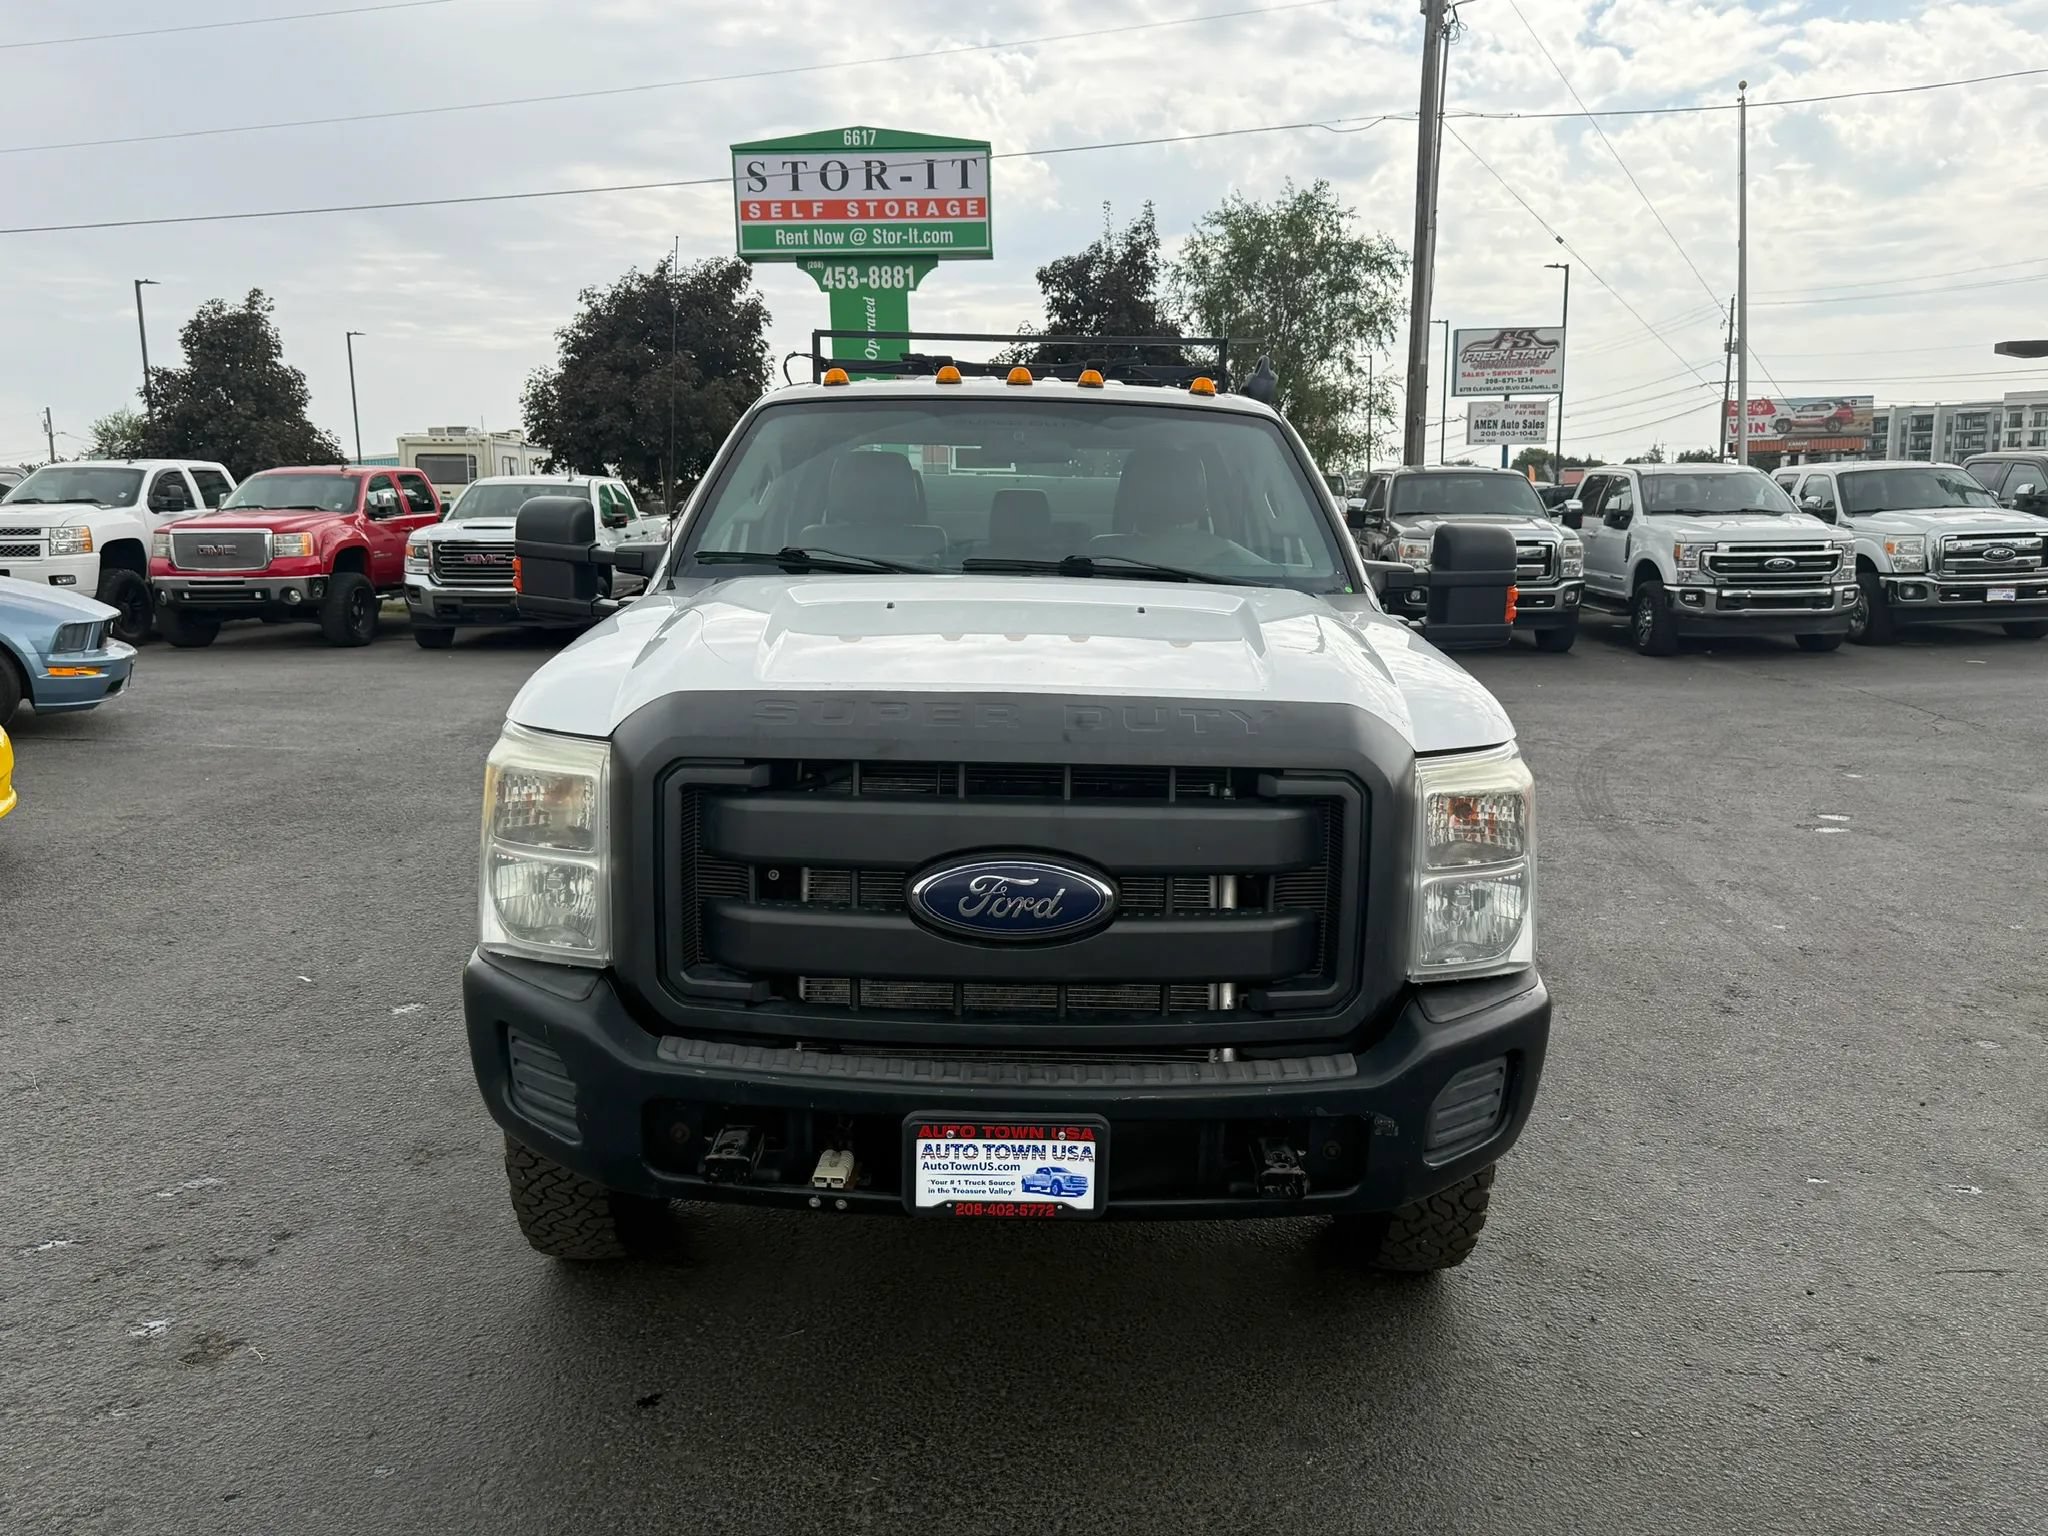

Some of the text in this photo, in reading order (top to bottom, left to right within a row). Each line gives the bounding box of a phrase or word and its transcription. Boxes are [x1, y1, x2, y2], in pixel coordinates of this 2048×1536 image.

[843, 129, 877, 146] 6617
[746, 158, 978, 193] STOR-IT
[749, 200, 979, 218] SELF STORAGE
[775, 228, 954, 246] Rent Now @ Stor-It.com
[807, 260, 824, 270] (208)
[822, 265, 915, 290] 453-8881
[864, 297, 880, 361] Oprated
[1462, 347, 1555, 362] FRESH START
[1474, 419, 1545, 430] AMEN Auto Sales
[197, 544, 237, 556] GMC
[464, 554, 506, 564] GMC
[752, 699, 1276, 735] SUPER DUTY
[958, 874, 1066, 920] Ford
[918, 1125, 1095, 1140] AUTO TOWN USA
[920, 1143, 1095, 1162] AUTO TOWN USA
[922, 1161, 1021, 1172] AutoTownUS.com
[952, 1187, 987, 1195] Treasure
